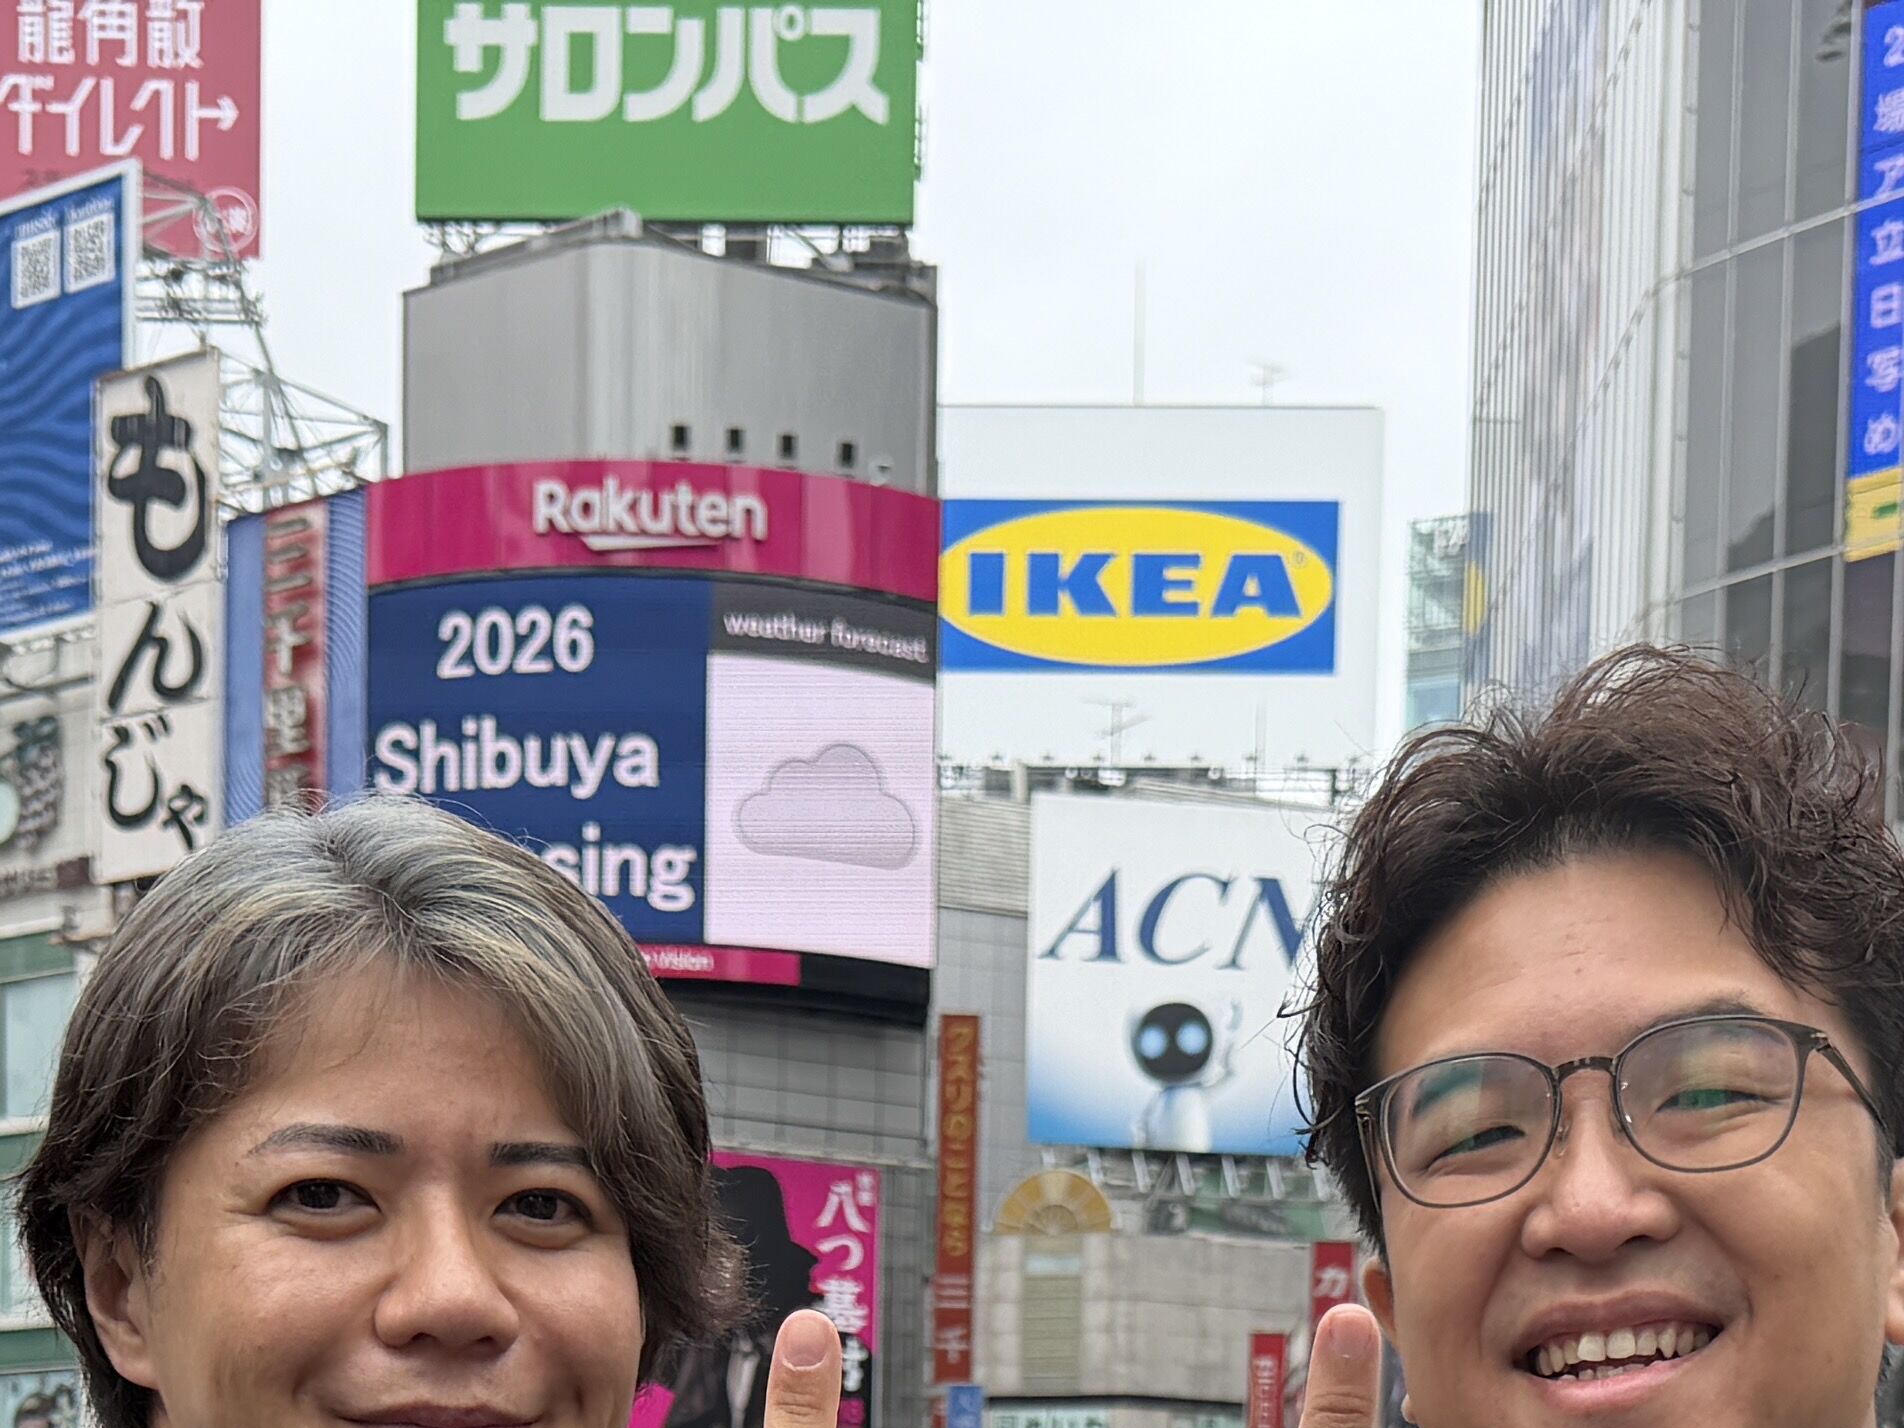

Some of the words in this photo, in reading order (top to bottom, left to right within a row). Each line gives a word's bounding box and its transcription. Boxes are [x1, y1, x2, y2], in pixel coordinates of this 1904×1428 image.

[16, 0, 204, 68] 龍角散
[442, 2, 890, 125] サロンパス
[533, 477, 768, 541] Rakuten
[968, 551, 1303, 619] IKEA
[436, 604, 595, 680] 2026
[723, 611, 829, 645] weather
[831, 617, 930, 664] forecast
[374, 714, 660, 800] Shibuya
